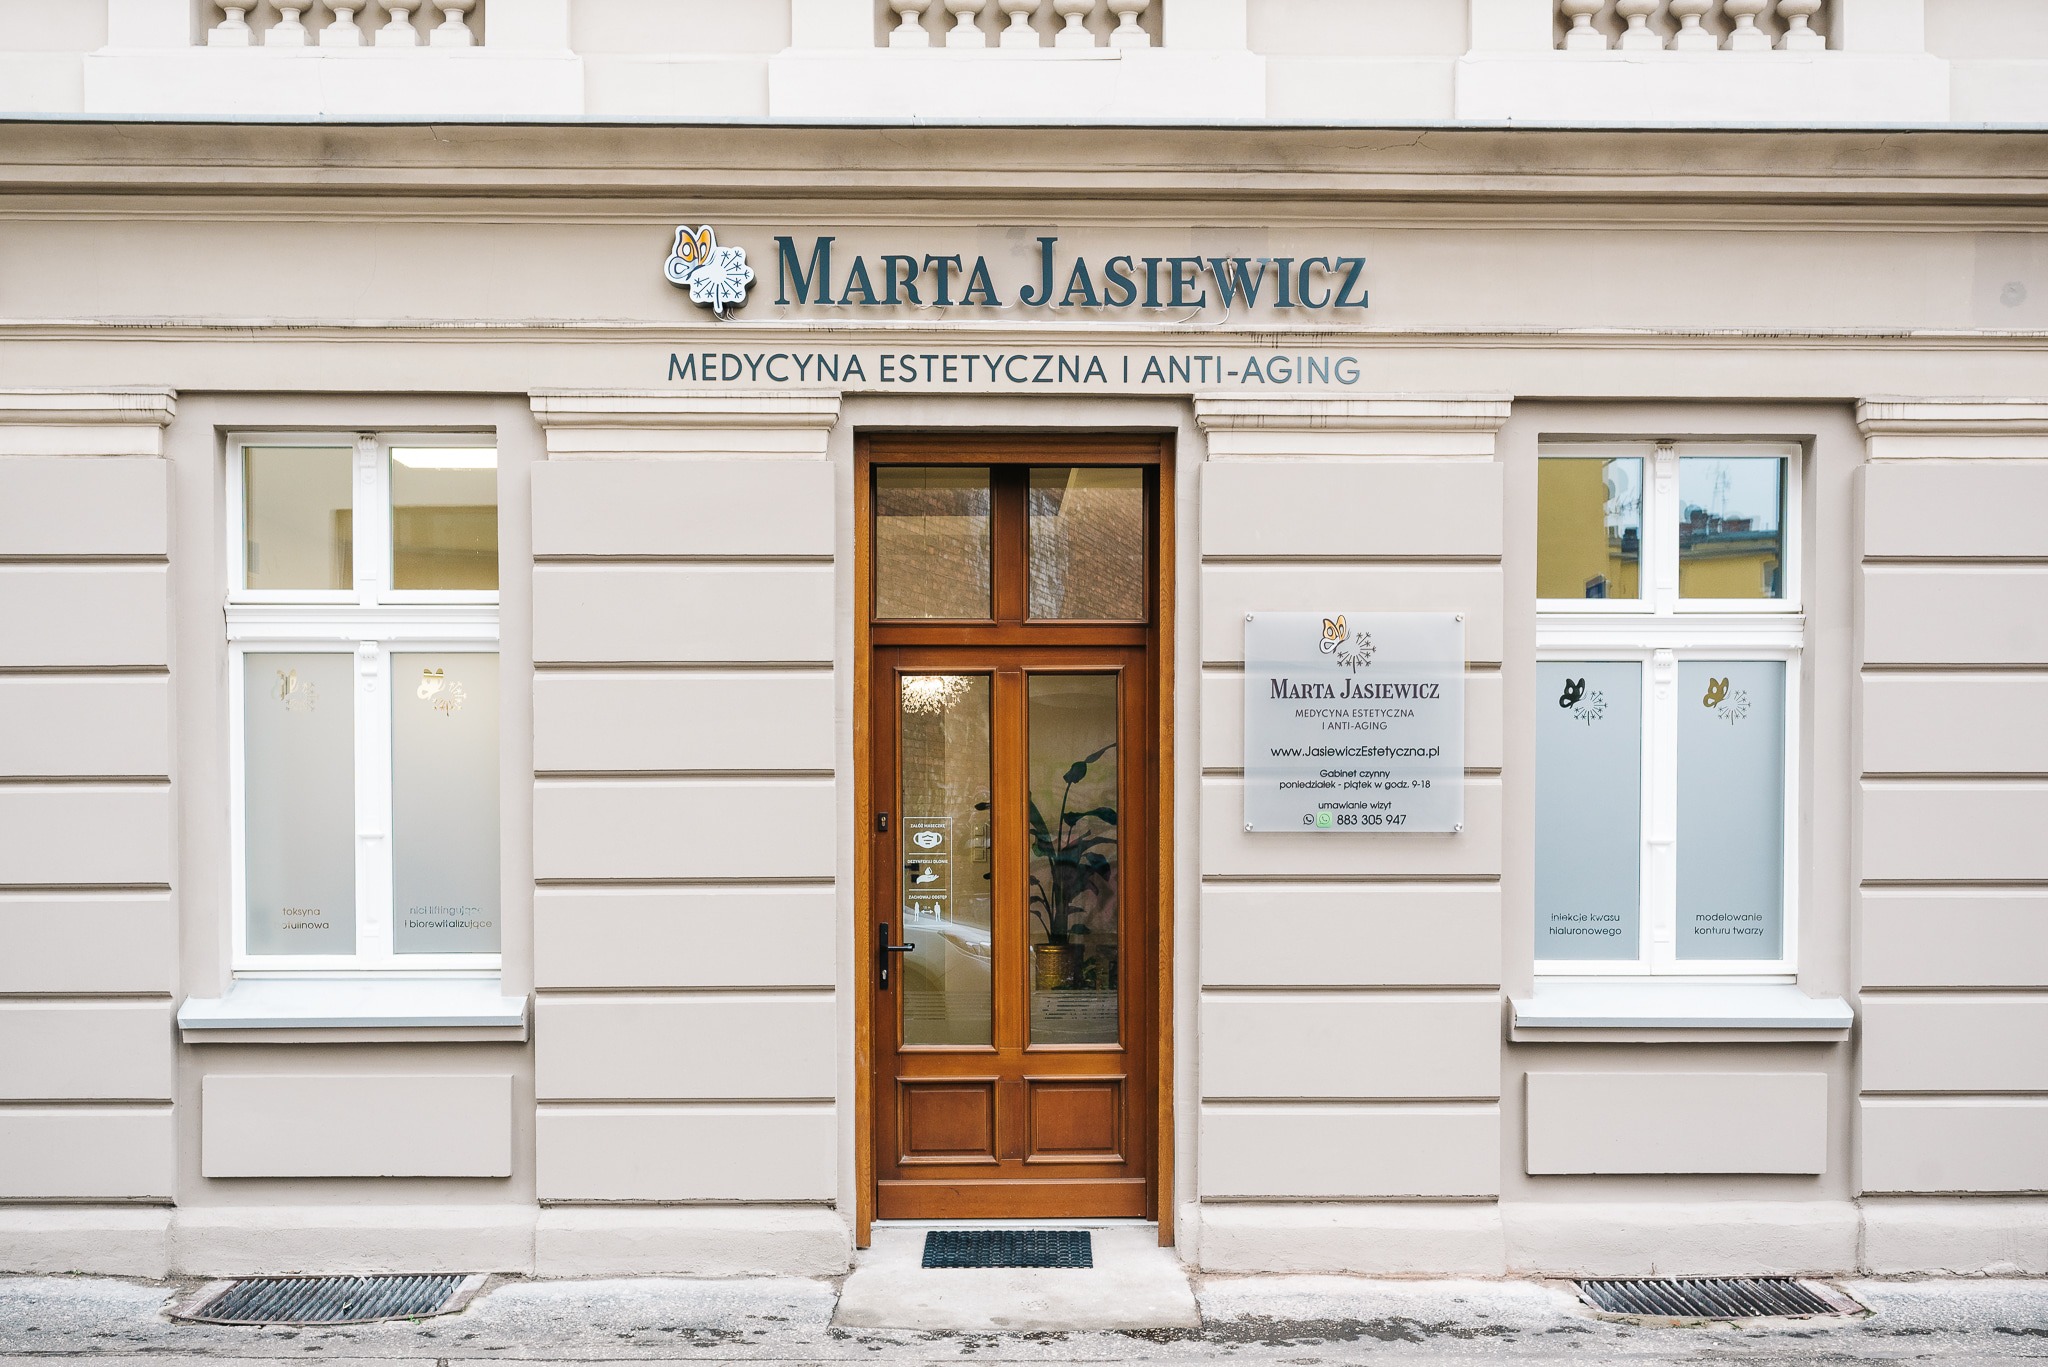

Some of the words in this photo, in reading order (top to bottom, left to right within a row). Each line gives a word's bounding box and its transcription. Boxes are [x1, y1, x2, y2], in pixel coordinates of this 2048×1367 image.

[668, 353, 867, 382] MEDYCYNA
[880, 354, 1107, 383] ESTETYCZNA
[1123, 355, 1129, 383] I
[1142, 356, 1361, 385] ANTI-AGING
[1295, 709, 1349, 718] MEDYCYNA
[1352, 709, 1414, 718] ESTETYCZNA
[1322, 722, 1324, 730] I
[1328, 722, 1387, 730] ANTI-AGING
[1271, 746, 1440, 758] www.JasiewiczEstetyczna.pl
[1320, 769, 1357, 778] Gabinet
[1359, 771, 1390, 779] czynny
[1279, 780, 1335, 790] poniedziałek
[1344, 780, 1372, 790] piątek
[1385, 780, 1409, 790] godz.
[1412, 780, 1430, 788] 9-18
[1319, 801, 1367, 810] umawianie
[1370, 801, 1391, 811] wizyt
[1337, 814, 1357, 825] 883
[1362, 814, 1382, 825] 305
[1386, 814, 1406, 825] 947
[283, 907, 320, 917] toksyna
[1696, 913, 1762, 921] modelowanie
[1551, 913, 1588, 923] iniekcje
[1590, 913, 1620, 922] kwasu
[409, 919, 492, 929] biorewitalizujące
[1549, 926, 1622, 937] hialuronowego
[1694, 926, 1730, 935] konturu
[1733, 926, 1764, 936] twarzy
